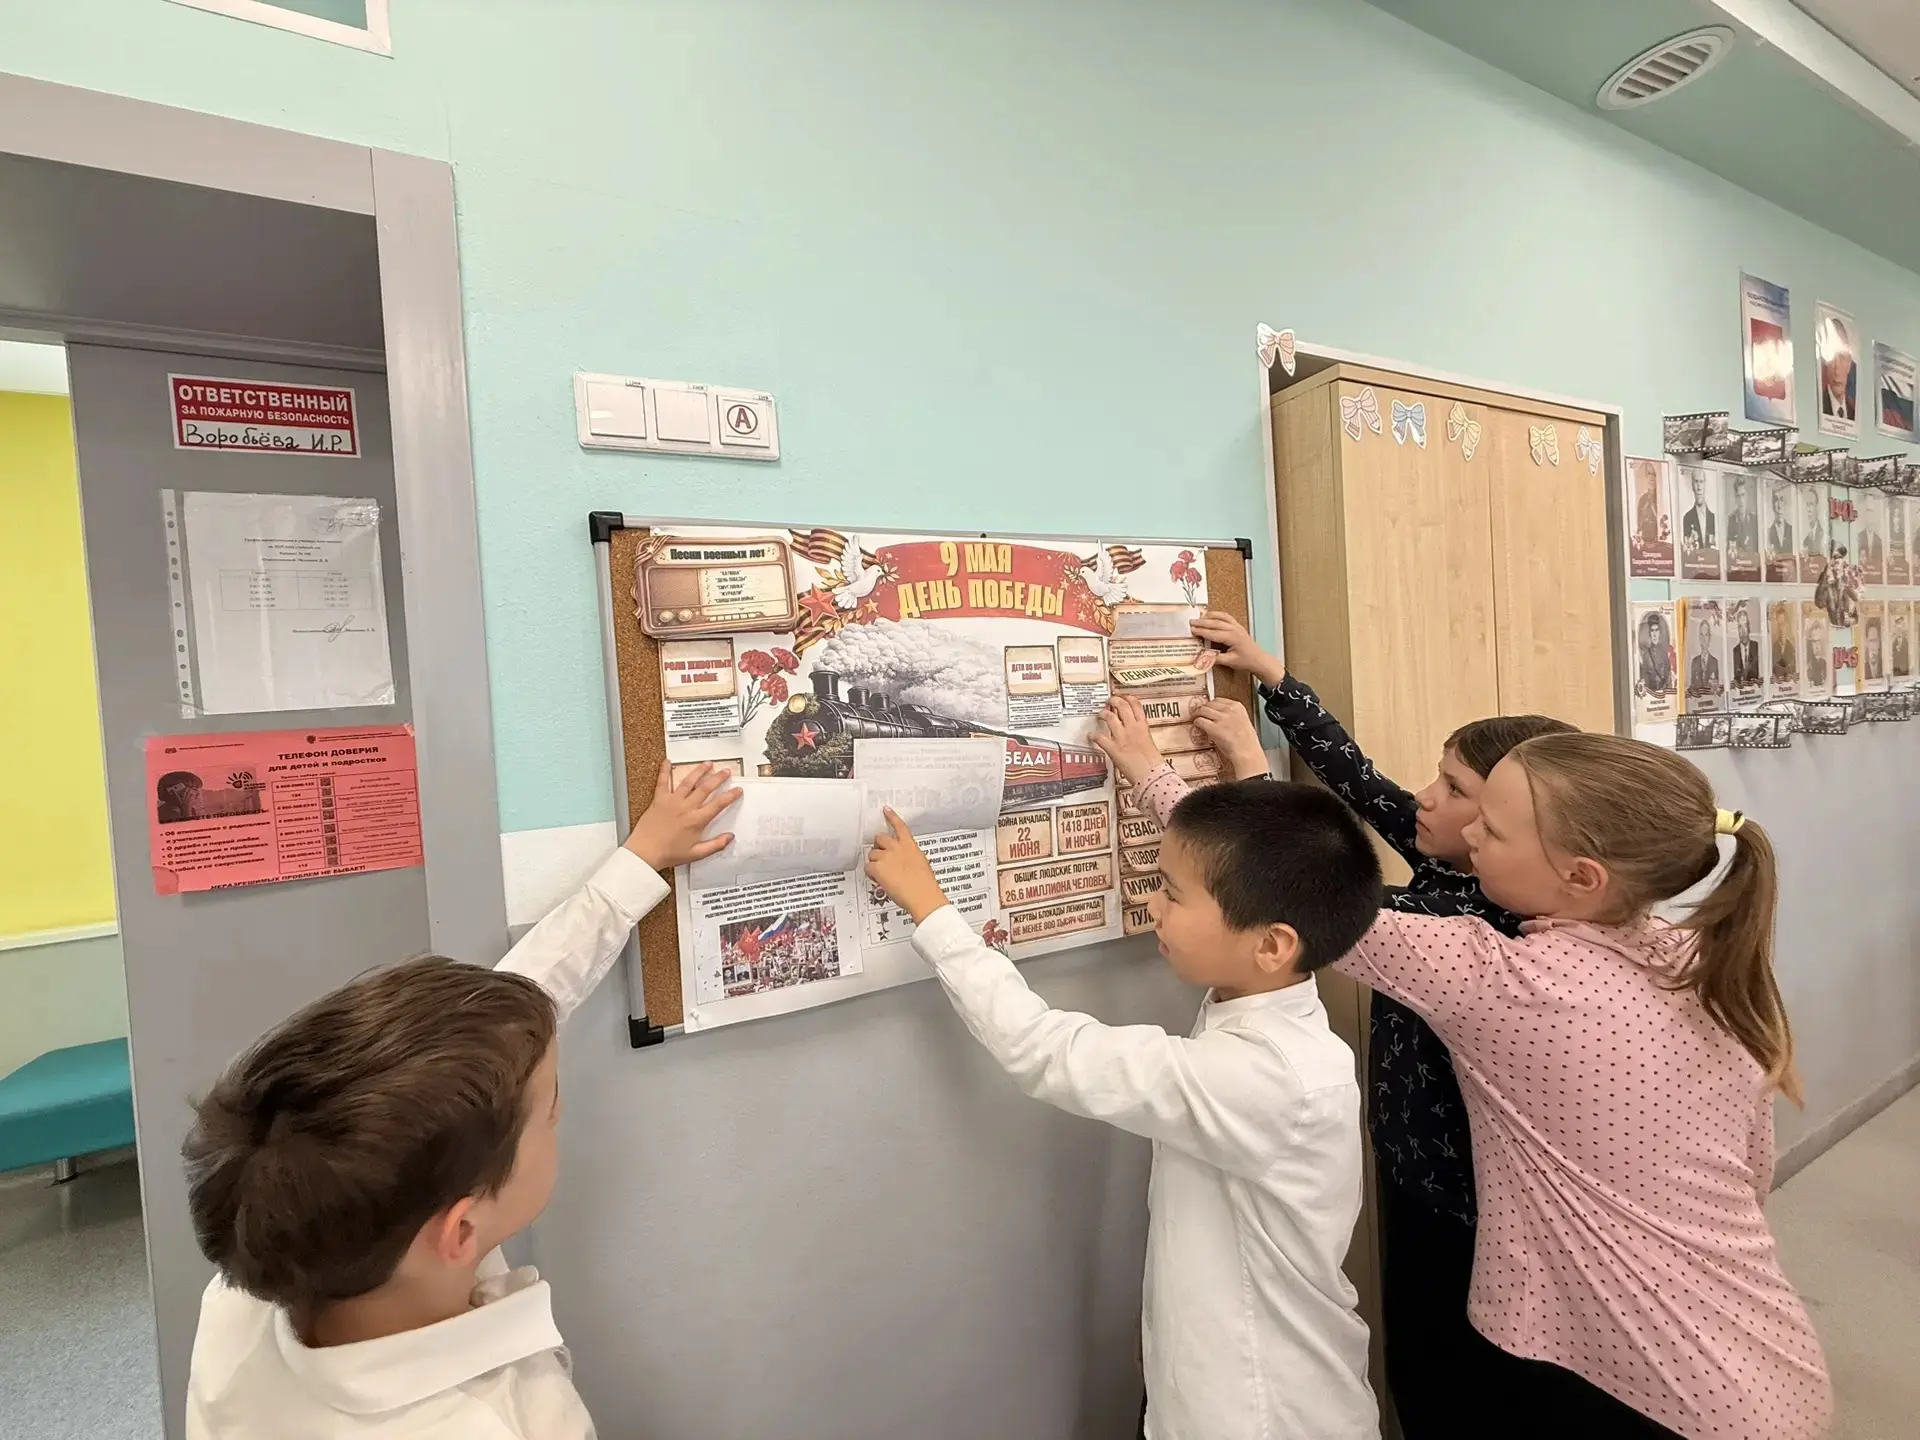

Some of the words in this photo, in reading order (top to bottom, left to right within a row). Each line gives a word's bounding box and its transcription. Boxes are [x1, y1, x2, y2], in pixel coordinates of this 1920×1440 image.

[178, 385, 349, 412] ОТВЕТСТВЕННЫЙ
[181, 404, 197, 415] ЗА
[200, 407, 264, 419] ПОЖАРНУЮ
[267, 411, 349, 425] БЕЗОПАСНОСТЬ
[186, 423, 300, 449] Воробьёва
[311, 433, 343, 451] И.Р.
[669, 548, 702, 560] Песни
[703, 550, 747, 560] военных
[749, 549, 765, 558] лет
[939, 541, 960, 577] 9
[964, 543, 1013, 574] МАЯ
[897, 579, 963, 619] ДЕНЬ
[967, 578, 1065, 618] ПОБЕДЫ
[1142, 701, 1181, 719] ИНГРАД
[277, 750, 329, 761] ТЕЛЕФОН
[330, 746, 379, 757] ДОВЕРИЯ
[1005, 751, 1051, 767] БЕДА!
[268, 765, 288, 773] для
[331, 757, 387, 767] подростков
[998, 817, 1018, 828] ВОЙНА
[1018, 813, 1050, 825] НАЧАЛАСЬ
[1062, 809, 1074, 819] ОНА
[1074, 807, 1102, 818] ДЛИЛАСЬ
[1061, 819, 1082, 834] 1418
[1083, 815, 1107, 831] ДНЕЙ
[1017, 827, 1031, 843] 22
[1065, 836, 1072, 849] И
[1074, 831, 1101, 848] НОЧЕЙ
[1009, 840, 1040, 859] ИЮНЯ
[281, 871, 319, 880] ПРОБЛЕМ
[1014, 870, 1038, 883] ОБЩИЕ
[1039, 865, 1072, 880] ЛЮДСКИЕ
[1025, 881, 1072, 899] МИЛЛИОНА
[1072, 874, 1107, 889] ЧЕЛОВЕК
[1126, 876, 1164, 896] МУРМА
[1012, 927, 1021, 937] НЕ
[1022, 923, 1042, 935] МЕНЕЕ
[1043, 920, 1055, 930] 800
[1057, 915, 1077, 927] ТЫСЯЧ
[1077, 911, 1103, 923] ЧЕЛОВЕК
[1013, 912, 1038, 924] ЖЕРТВЫ
[1038, 907, 1065, 919] БЛОКАДЫ
